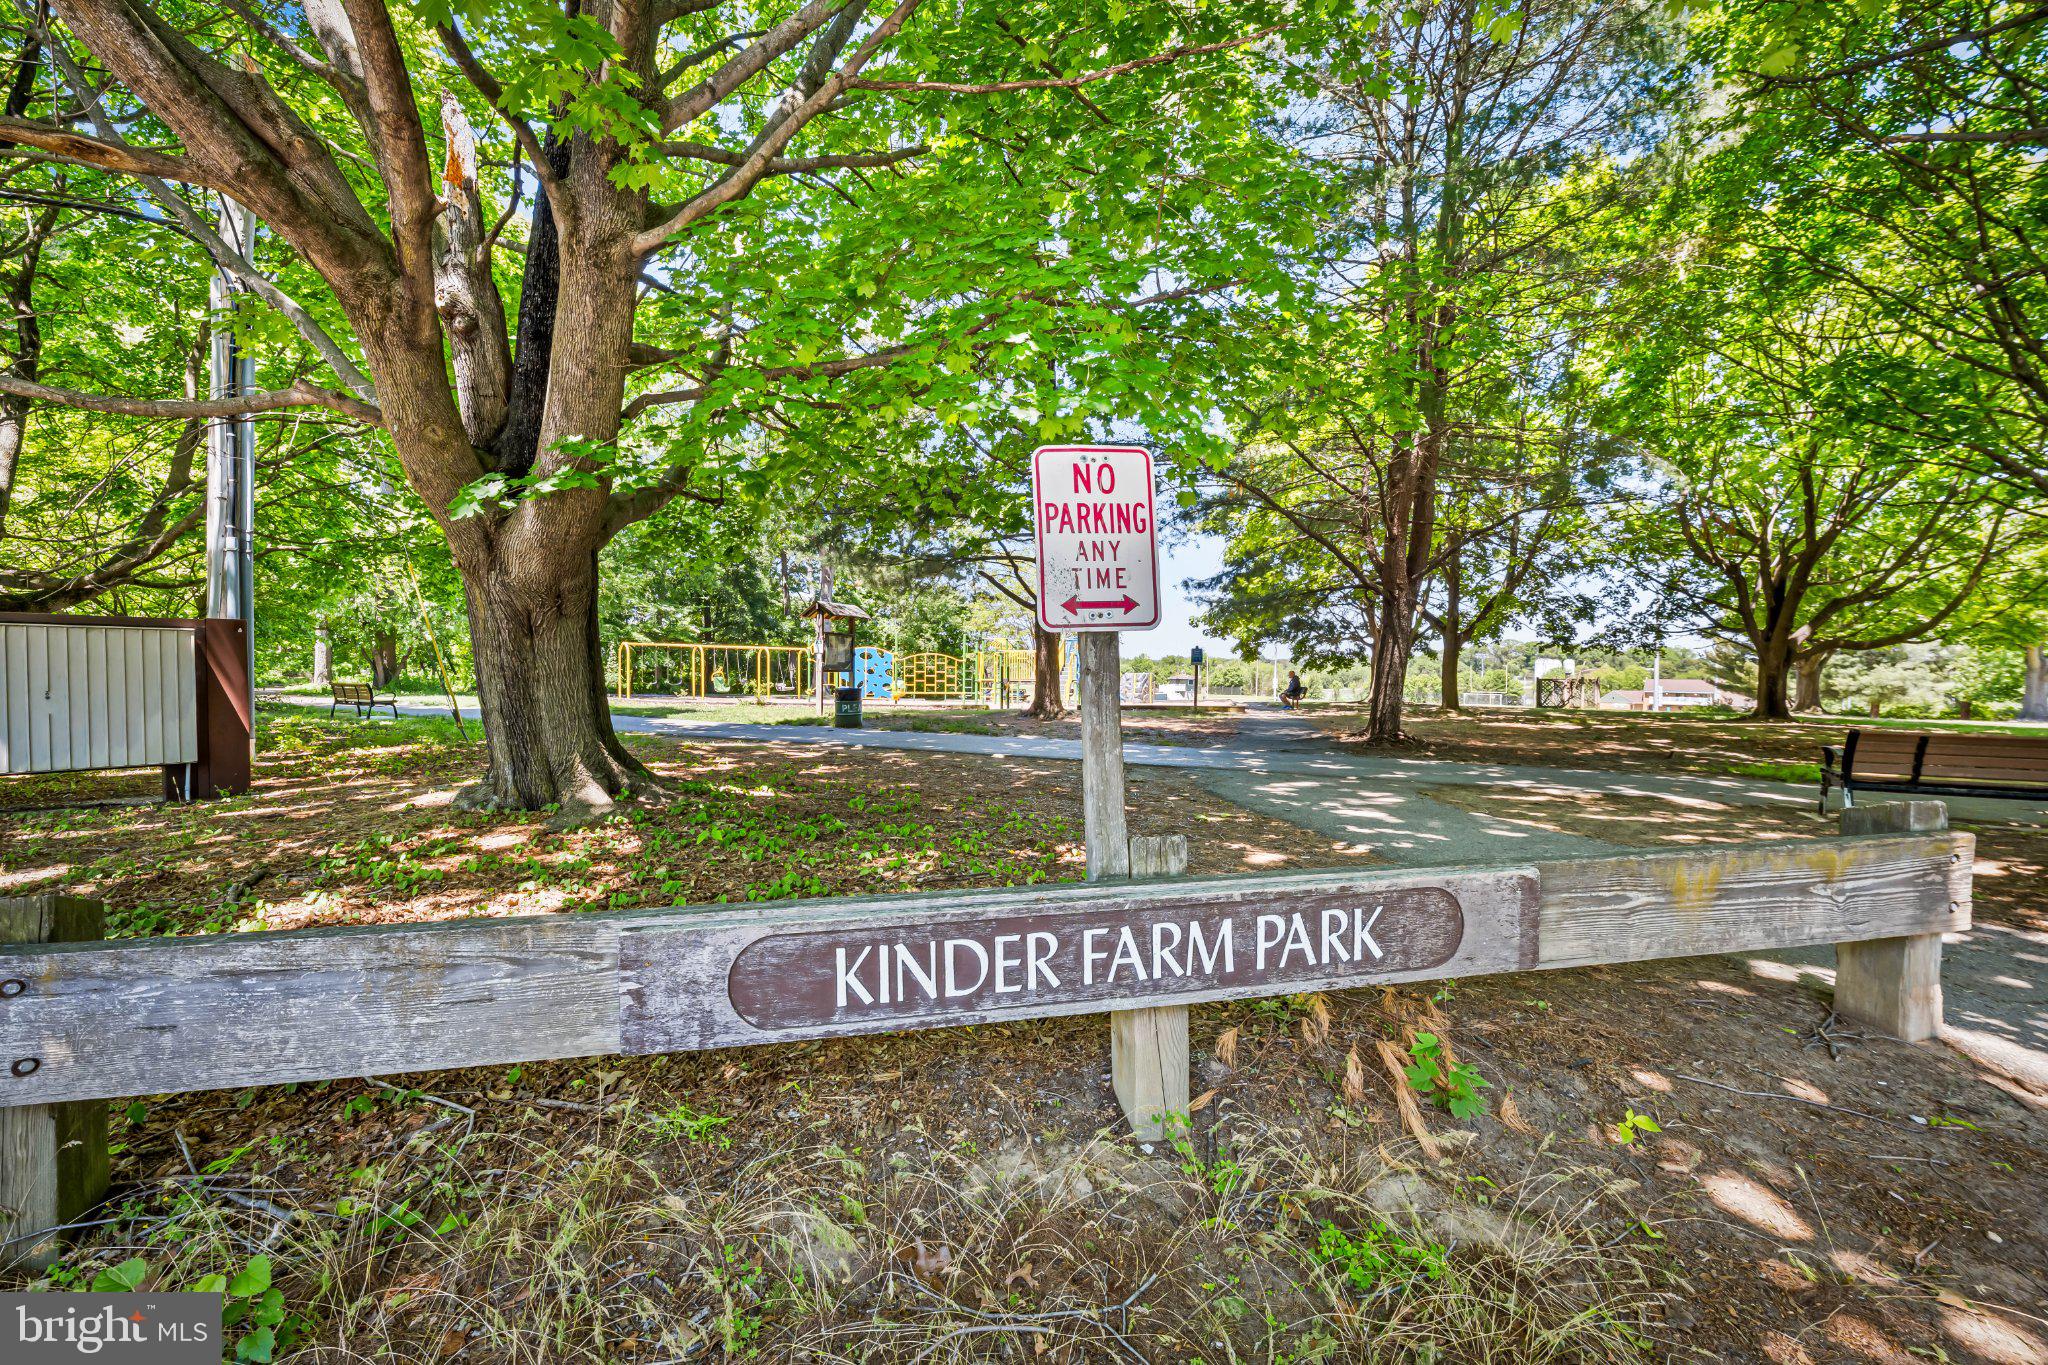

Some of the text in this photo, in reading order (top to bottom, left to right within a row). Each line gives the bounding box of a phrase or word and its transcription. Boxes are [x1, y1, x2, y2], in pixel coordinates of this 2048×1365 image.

[1072, 463, 1115, 494] NO
[1044, 502, 1147, 534] PARKING
[1075, 540, 1121, 562] ANY
[1071, 567, 1127, 589] TIME
[835, 906, 1385, 1007] KINDER FARM PARK
